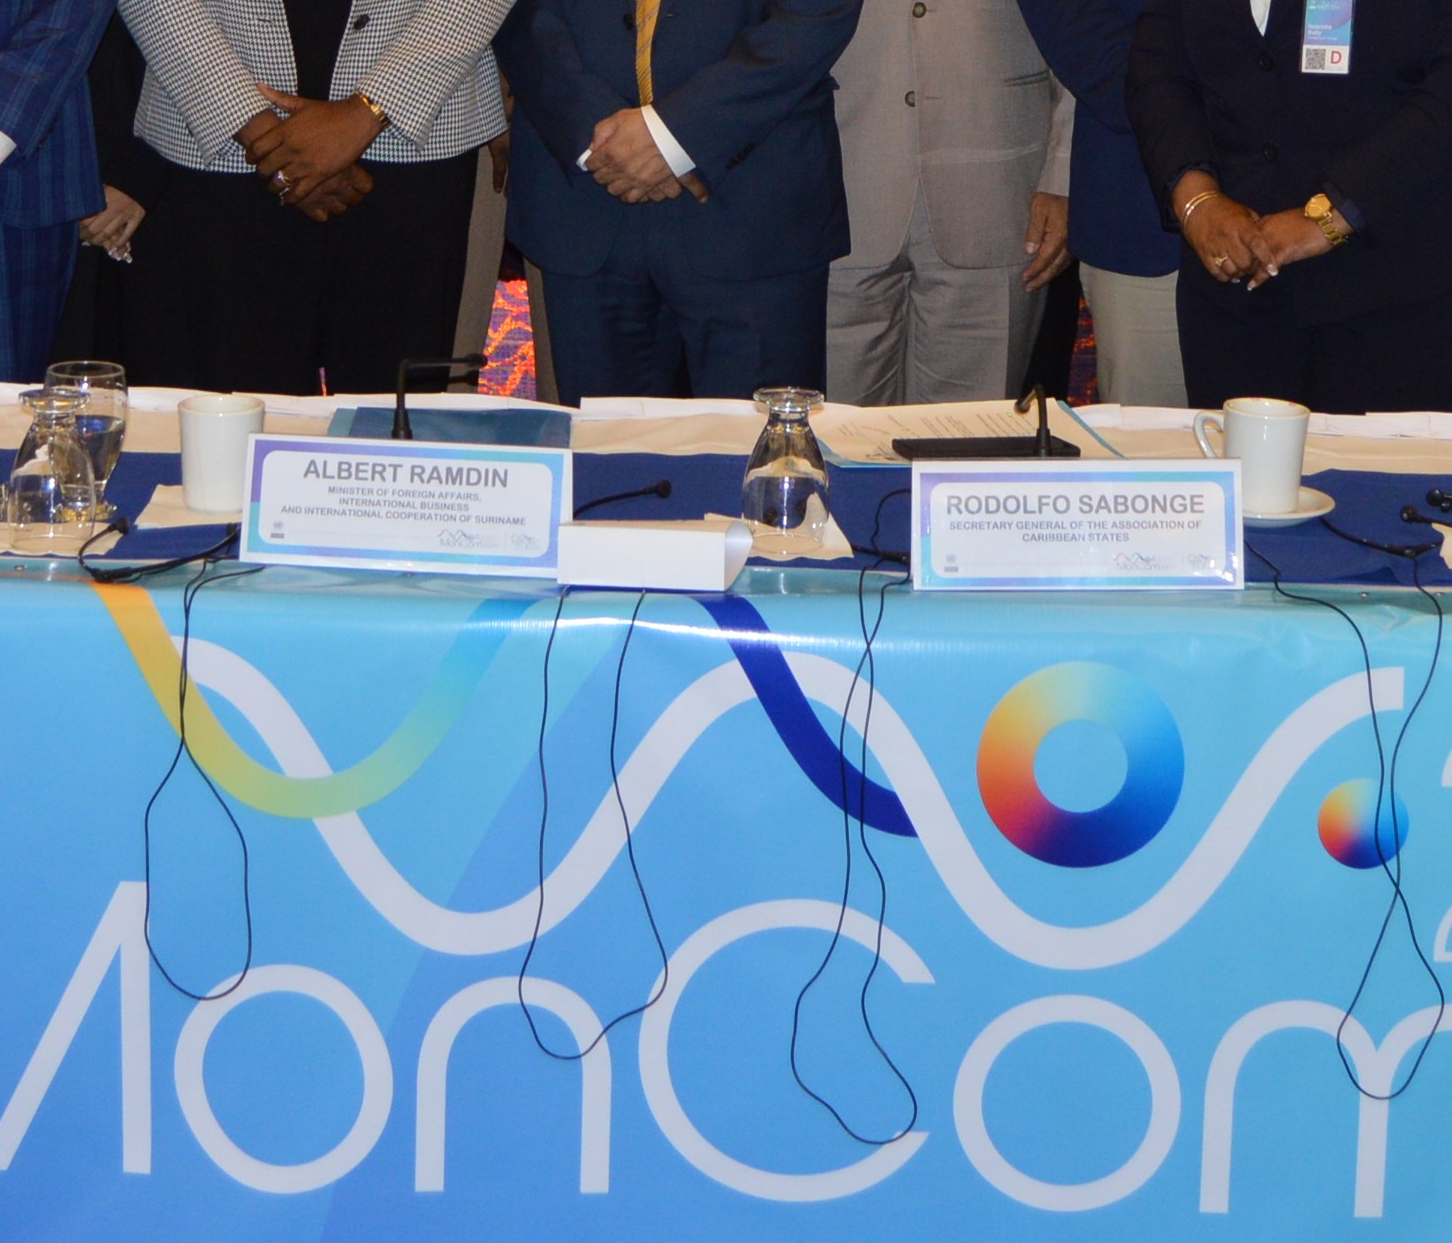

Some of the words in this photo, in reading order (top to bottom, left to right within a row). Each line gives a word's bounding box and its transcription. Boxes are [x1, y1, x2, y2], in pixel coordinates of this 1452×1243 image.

[1330, 50, 1342, 64] D
[303, 459, 403, 483] ALBERT
[409, 465, 508, 488] RAMDIN
[328, 486, 374, 497] MINISTER
[376, 487, 389, 497] OF
[391, 488, 434, 499] FOREIGN
[436, 490, 482, 502] AFFAIRS,
[339, 498, 417, 510] INTERNATIONAL
[420, 501, 469, 512] BUSINESS
[947, 494, 1070, 515] RODOLFO
[1078, 493, 1204, 514] SABONGE
[281, 505, 302, 515] AND
[304, 506, 383, 519] INTERNATIONAL
[385, 510, 456, 523] COOPERATION
[459, 513, 473, 523] OF
[475, 514, 526, 526] SURINAME
[949, 520, 1013, 531] SECRETARY
[1016, 520, 1067, 531] GENERAL
[1069, 520, 1084, 531] OF
[1086, 520, 1108, 531] THE
[1110, 520, 1185, 530] ASSOCIATION
[1187, 519, 1202, 530] OF
[1022, 532, 1085, 543] CARIBBEAN
[1088, 532, 1130, 543] STATES
